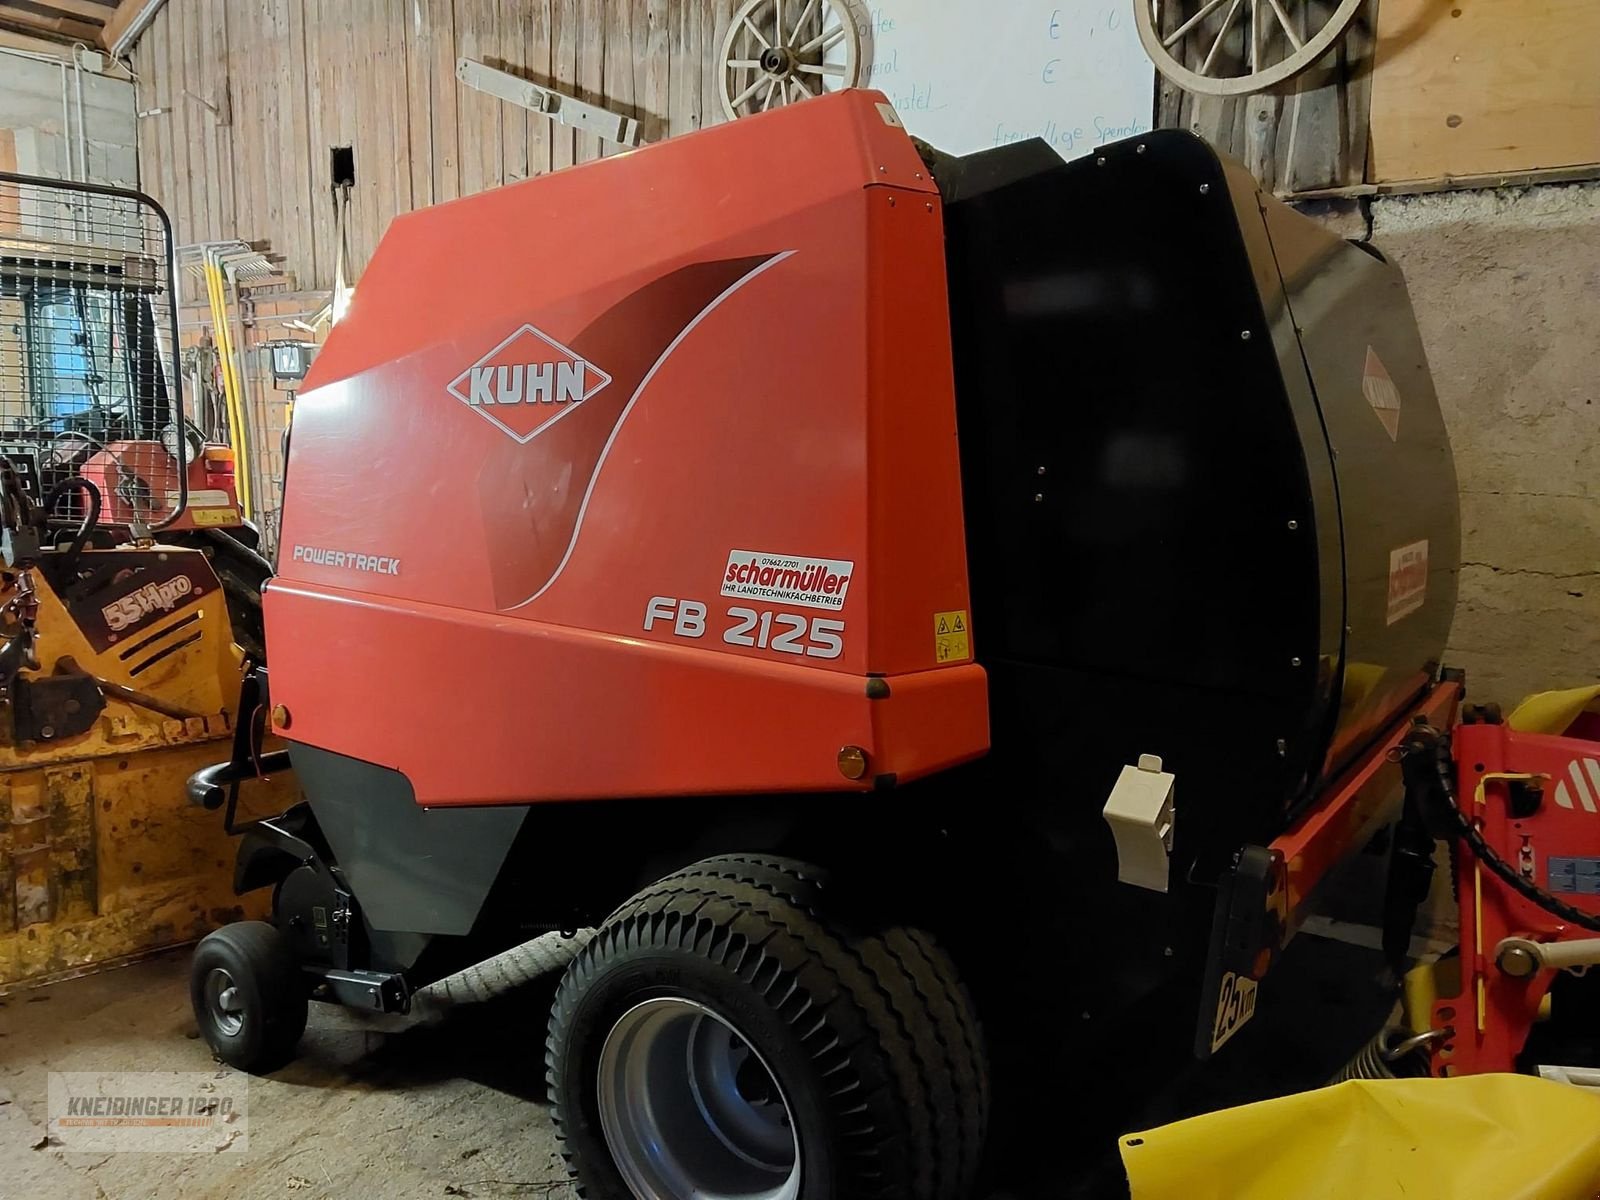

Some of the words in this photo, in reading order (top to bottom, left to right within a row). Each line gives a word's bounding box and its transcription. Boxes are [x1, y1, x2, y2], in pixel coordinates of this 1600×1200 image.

[469, 359, 585, 406] KUHN
[293, 544, 401, 576] POWERTRACK
[725, 558, 849, 595] scharmüller
[761, 557, 800, 569] 07662/2701
[722, 583, 737, 592] IHR
[737, 585, 843, 606] LANDTECHNIKFACHBETRIEB
[643, 596, 708, 638] FB
[722, 606, 846, 660] 2125
